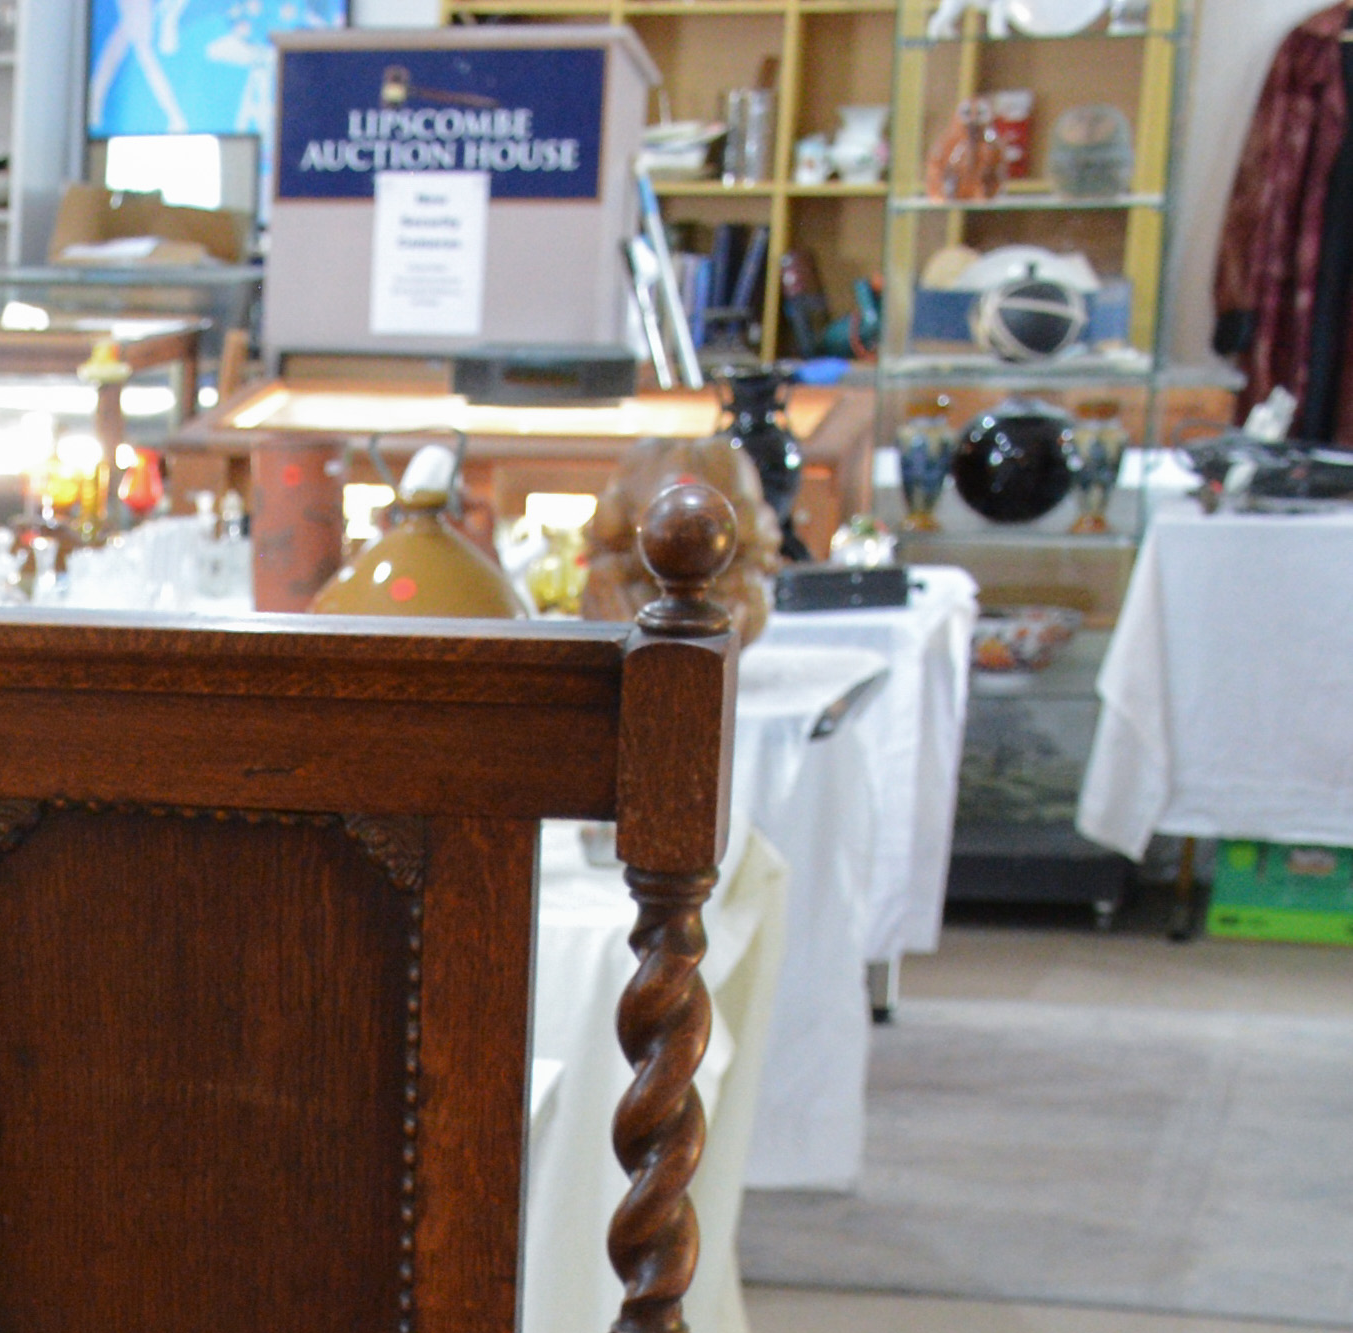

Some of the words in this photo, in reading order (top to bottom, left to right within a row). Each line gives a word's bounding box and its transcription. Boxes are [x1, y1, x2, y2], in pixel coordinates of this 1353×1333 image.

[348, 108, 533, 141] LIPSCOMBE
[299, 139, 457, 172] AUCTION
[463, 138, 580, 172] HOUSE
